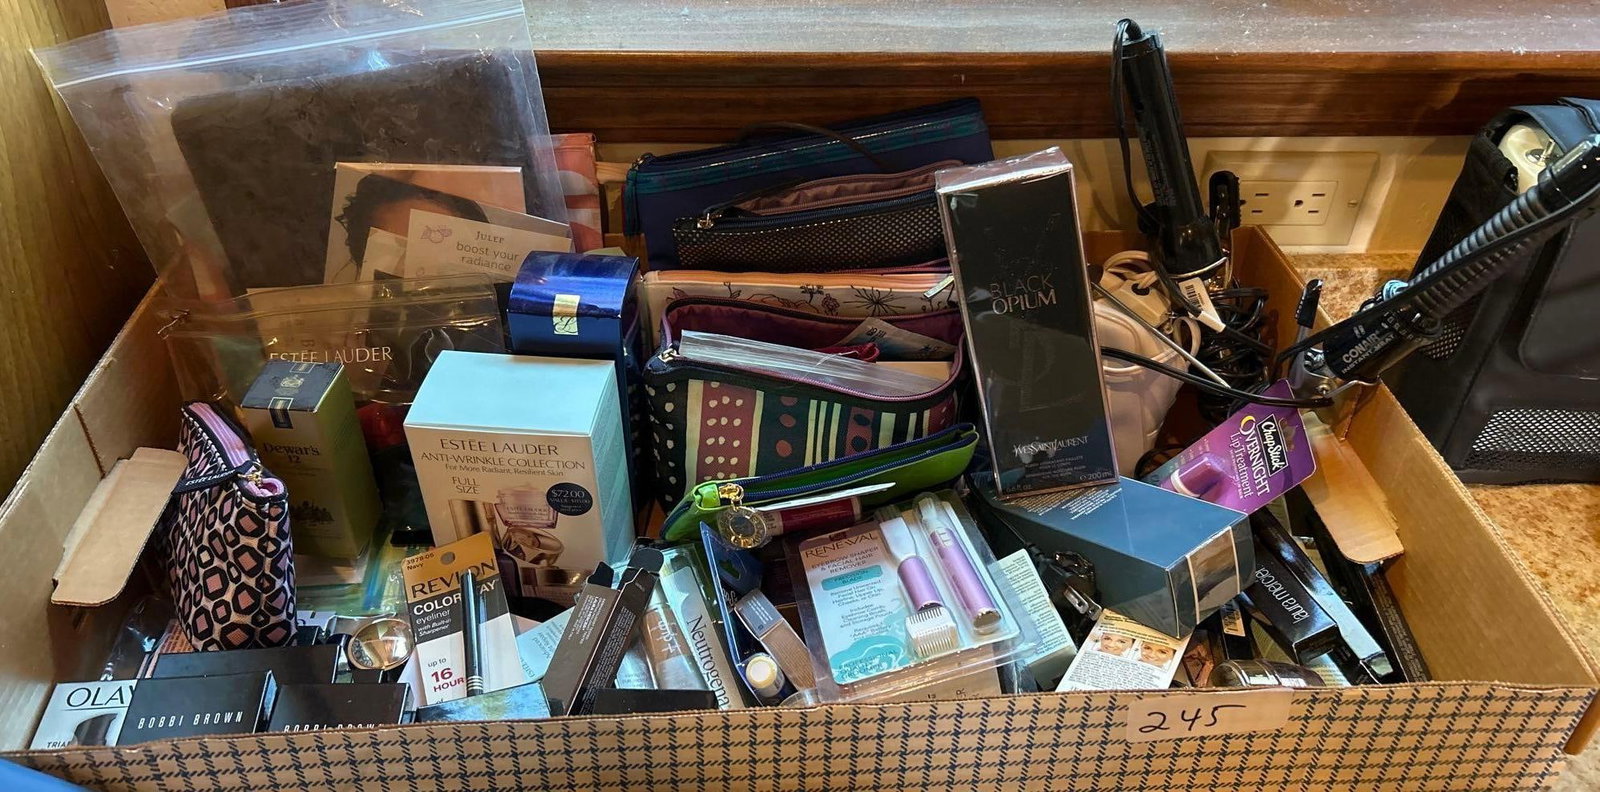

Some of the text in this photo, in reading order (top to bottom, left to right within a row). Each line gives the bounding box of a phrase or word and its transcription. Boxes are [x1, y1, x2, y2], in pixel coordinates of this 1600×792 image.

[456, 241, 520, 261] boost your
[461, 256, 512, 271] radiance
[989, 273, 1054, 300] BLACK
[992, 289, 1057, 315] OPIUM
[325, 346, 393, 363] LAUDER
[1342, 331, 1381, 363] CONAIR
[263, 442, 320, 456] Dewar's
[492, 442, 560, 456] LAUDER
[1261, 420, 1284, 471] ChapStick
[288, 455, 300, 464] 12
[420, 452, 586, 470] ANTI-WRINKLE COLLECTION
[1240, 415, 1270, 496] OVERNIGHT
[445, 463, 457, 471] For
[459, 465, 481, 473] More
[514, 468, 546, 476] Resilient
[547, 469, 564, 477] Skin
[1232, 447, 1254, 498] Treatment
[452, 476, 480, 487] FULL
[455, 485, 480, 495] SIZE
[805, 532, 879, 558] RENEWAL
[849, 546, 879, 560] SHAPER
[406, 563, 424, 571] Navy
[827, 559, 854, 571] FACIAL
[855, 553, 874, 563] HAIR
[829, 560, 867, 574] REMOVER
[415, 608, 451, 625] eyeliner
[1281, 597, 1310, 625] laura
[427, 657, 447, 668] up to
[687, 614, 731, 710] Neutrogena
[431, 667, 453, 684] 16
[433, 677, 466, 692] HOUR
[137, 710, 244, 729] BOBBI BROWN
[1138, 703, 1246, 734] 245
